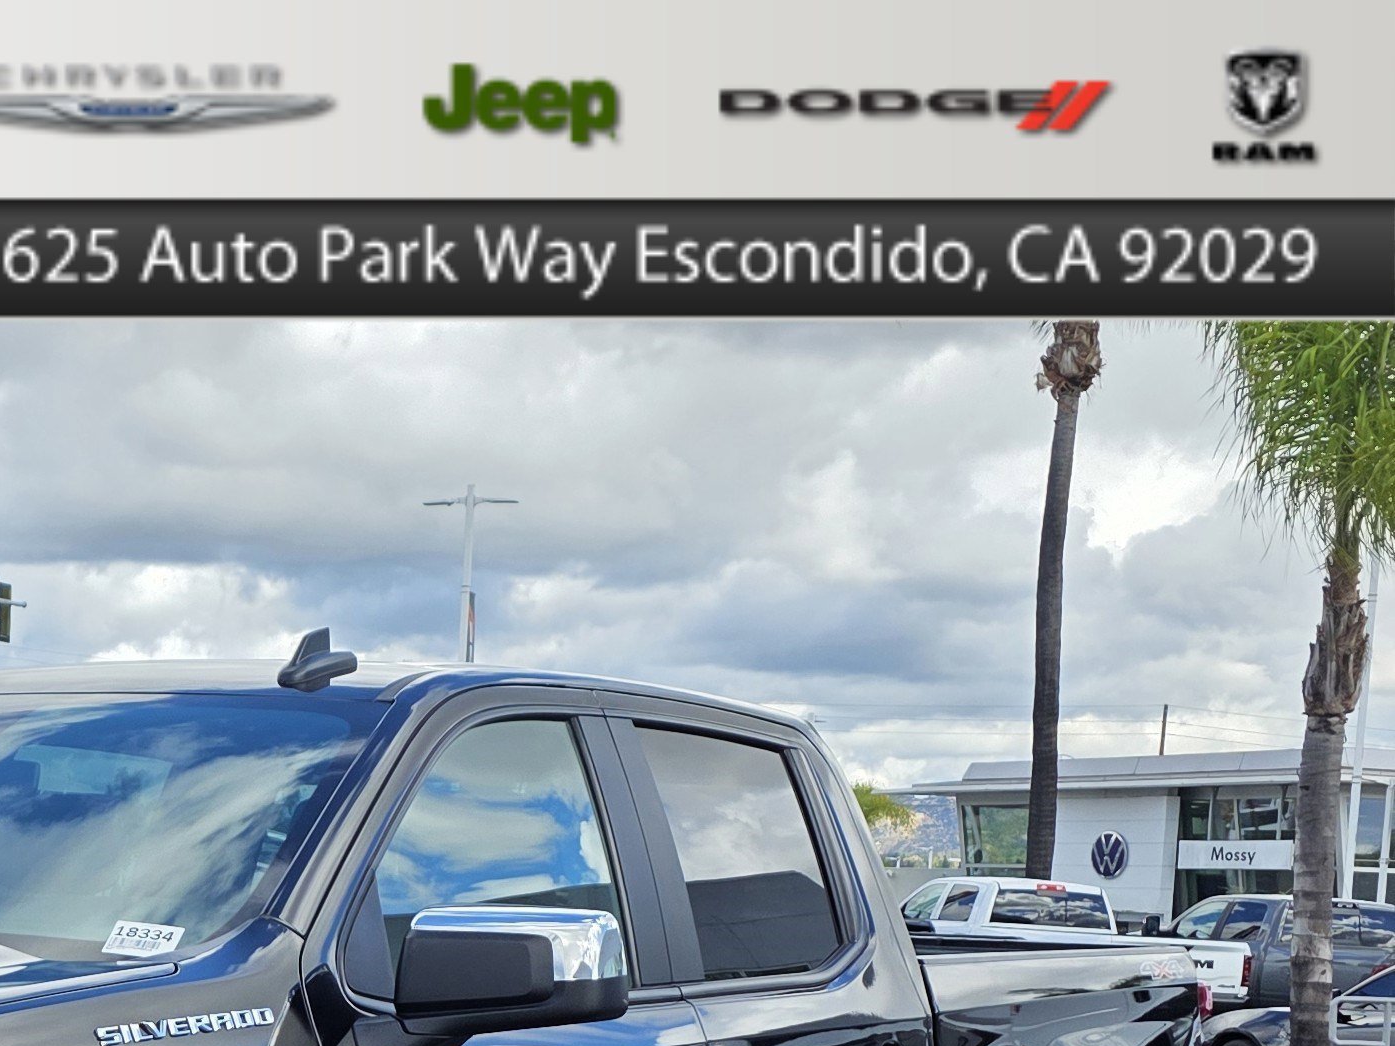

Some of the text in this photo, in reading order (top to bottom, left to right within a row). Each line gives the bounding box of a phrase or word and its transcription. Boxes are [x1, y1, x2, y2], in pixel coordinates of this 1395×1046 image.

[1211, 846, 1256, 865] Mossy
[114, 926, 174, 942] 18334
[94, 1006, 275, 1046] SILVERADO
